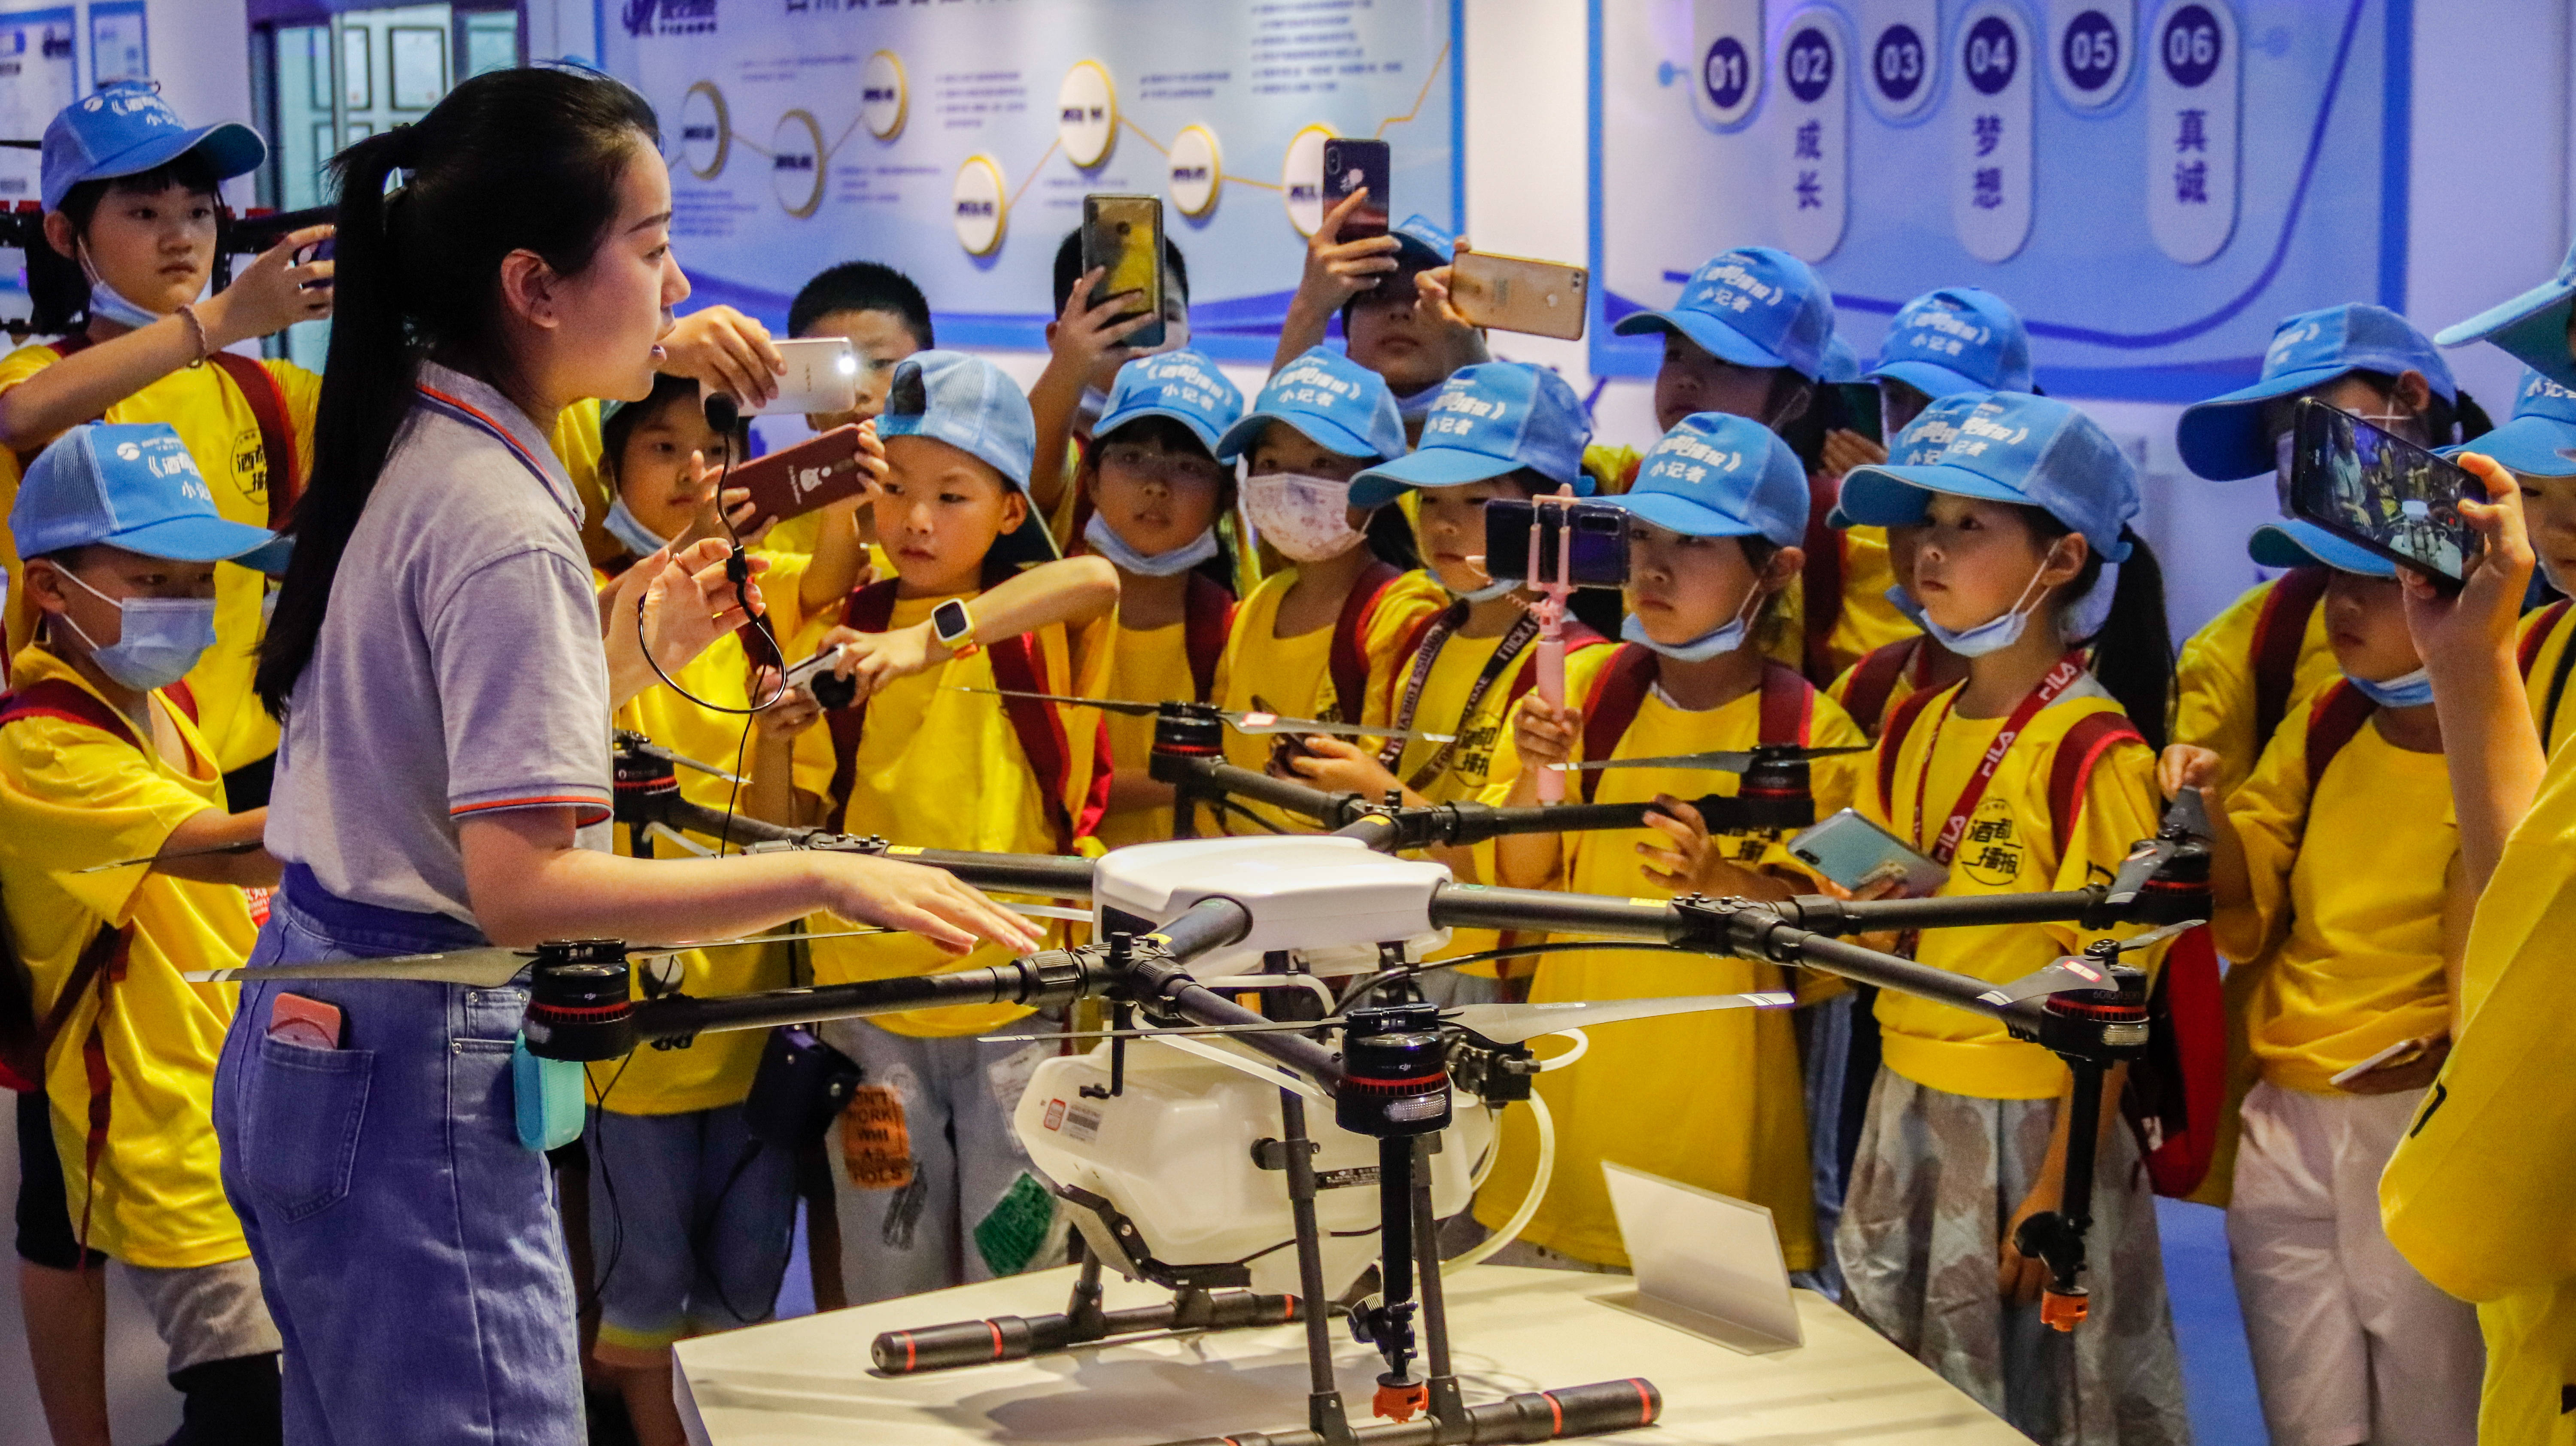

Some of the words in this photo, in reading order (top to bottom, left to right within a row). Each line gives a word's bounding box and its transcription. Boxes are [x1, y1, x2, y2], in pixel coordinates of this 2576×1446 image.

[1882, 43, 1919, 80] 03
[1971, 36, 2009, 73] 04
[2071, 31, 2114, 70] 05
[2169, 25, 2214, 66] 06
[1708, 55, 1741, 91] 01
[1791, 46, 1827, 83] 02
[1795, 120, 1821, 210] 成长
[1975, 115, 2002, 209] 梦想
[2174, 109, 2208, 204] 真诚
[1162, 383, 1214, 411] 小记者
[1278, 389, 1334, 407] 小记者
[1649, 460, 1707, 484] 小记者
[2038, 662, 2077, 700] FILA
[1982, 732, 2016, 777] FILA
[1938, 816, 1967, 863] FILA
[1967, 818, 2013, 843] 酒都
[1962, 847, 2018, 878] 播报
